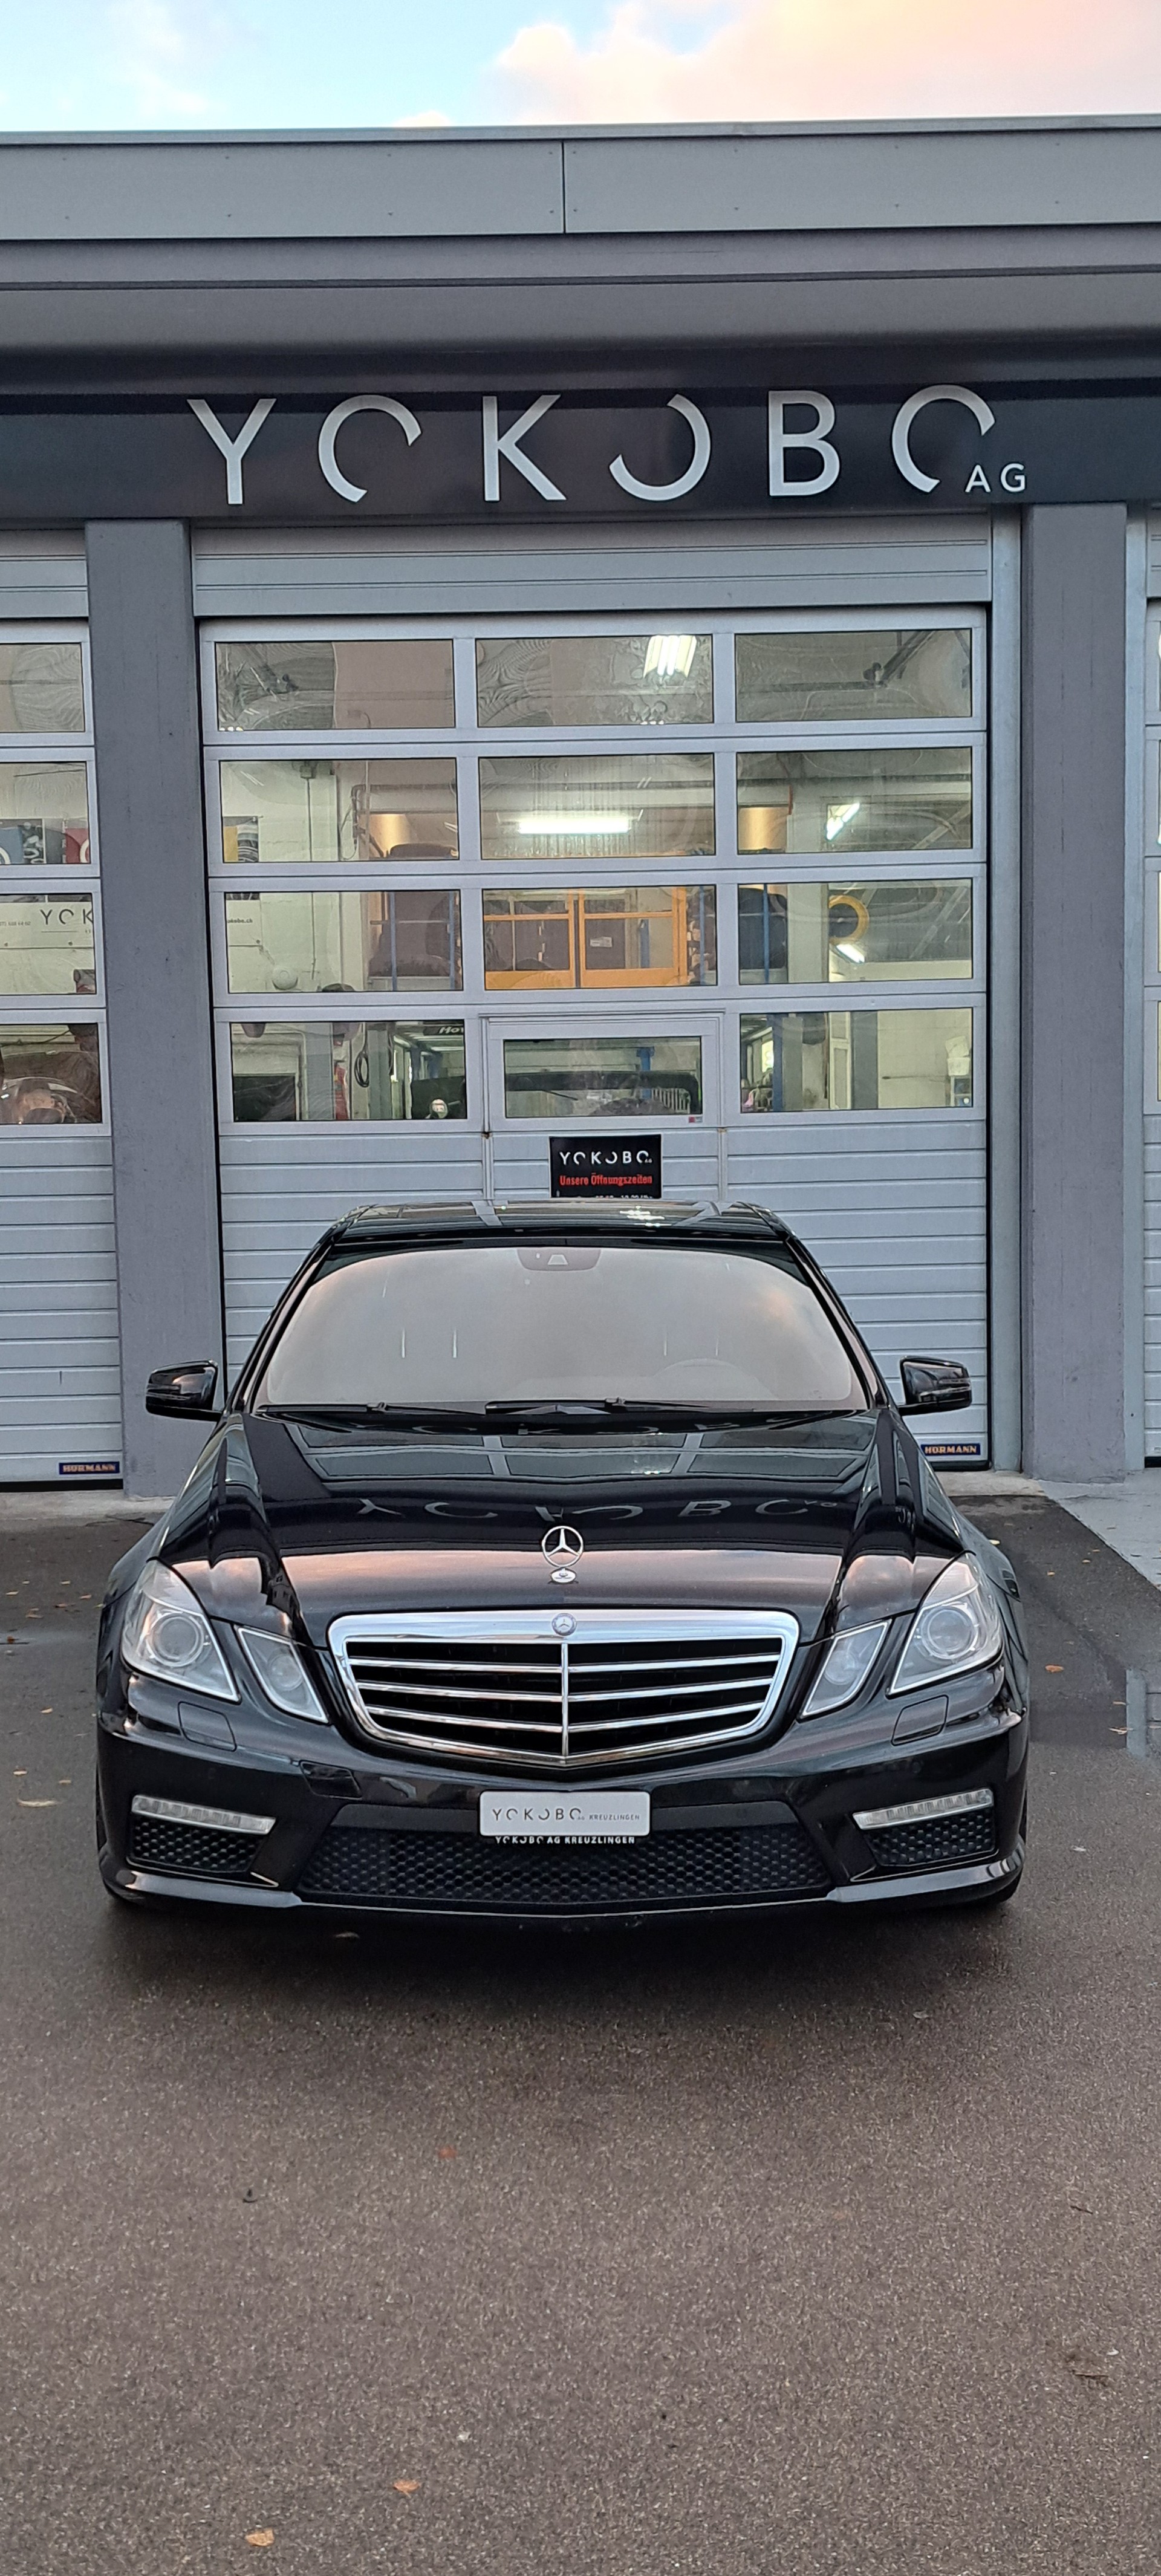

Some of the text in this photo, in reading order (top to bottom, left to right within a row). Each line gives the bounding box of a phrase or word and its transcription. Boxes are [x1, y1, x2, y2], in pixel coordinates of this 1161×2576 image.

[965, 464, 1026, 493] AG
[560, 1173, 652, 1186] Unsere Öffnungszeiten
